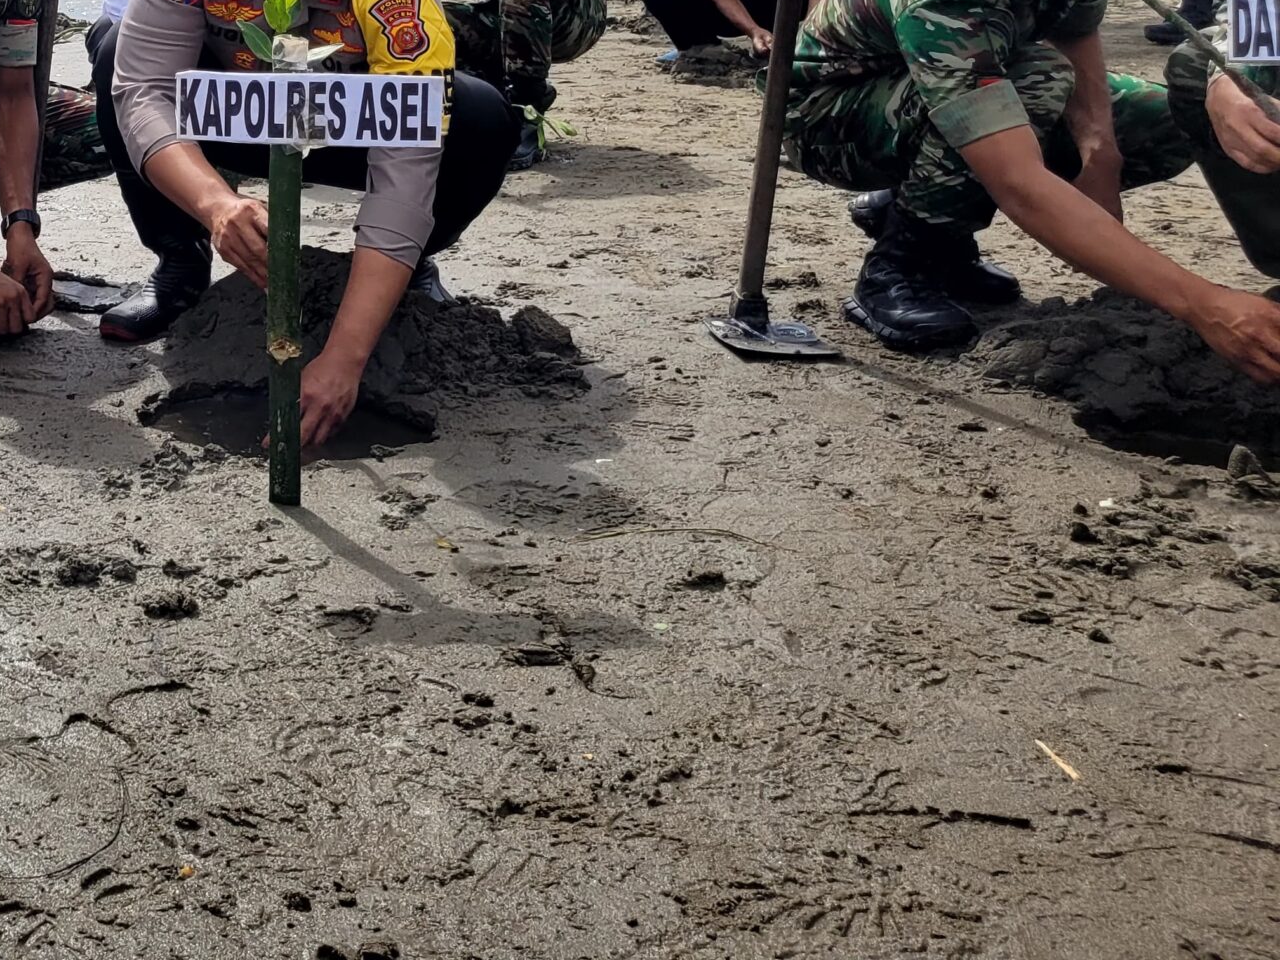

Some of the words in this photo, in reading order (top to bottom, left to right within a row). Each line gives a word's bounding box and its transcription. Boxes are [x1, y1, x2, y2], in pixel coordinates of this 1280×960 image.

[388, 11, 413, 22] ACEH
[179, 77, 347, 140] KAPOLRES
[355, 81, 438, 142] ASEL
